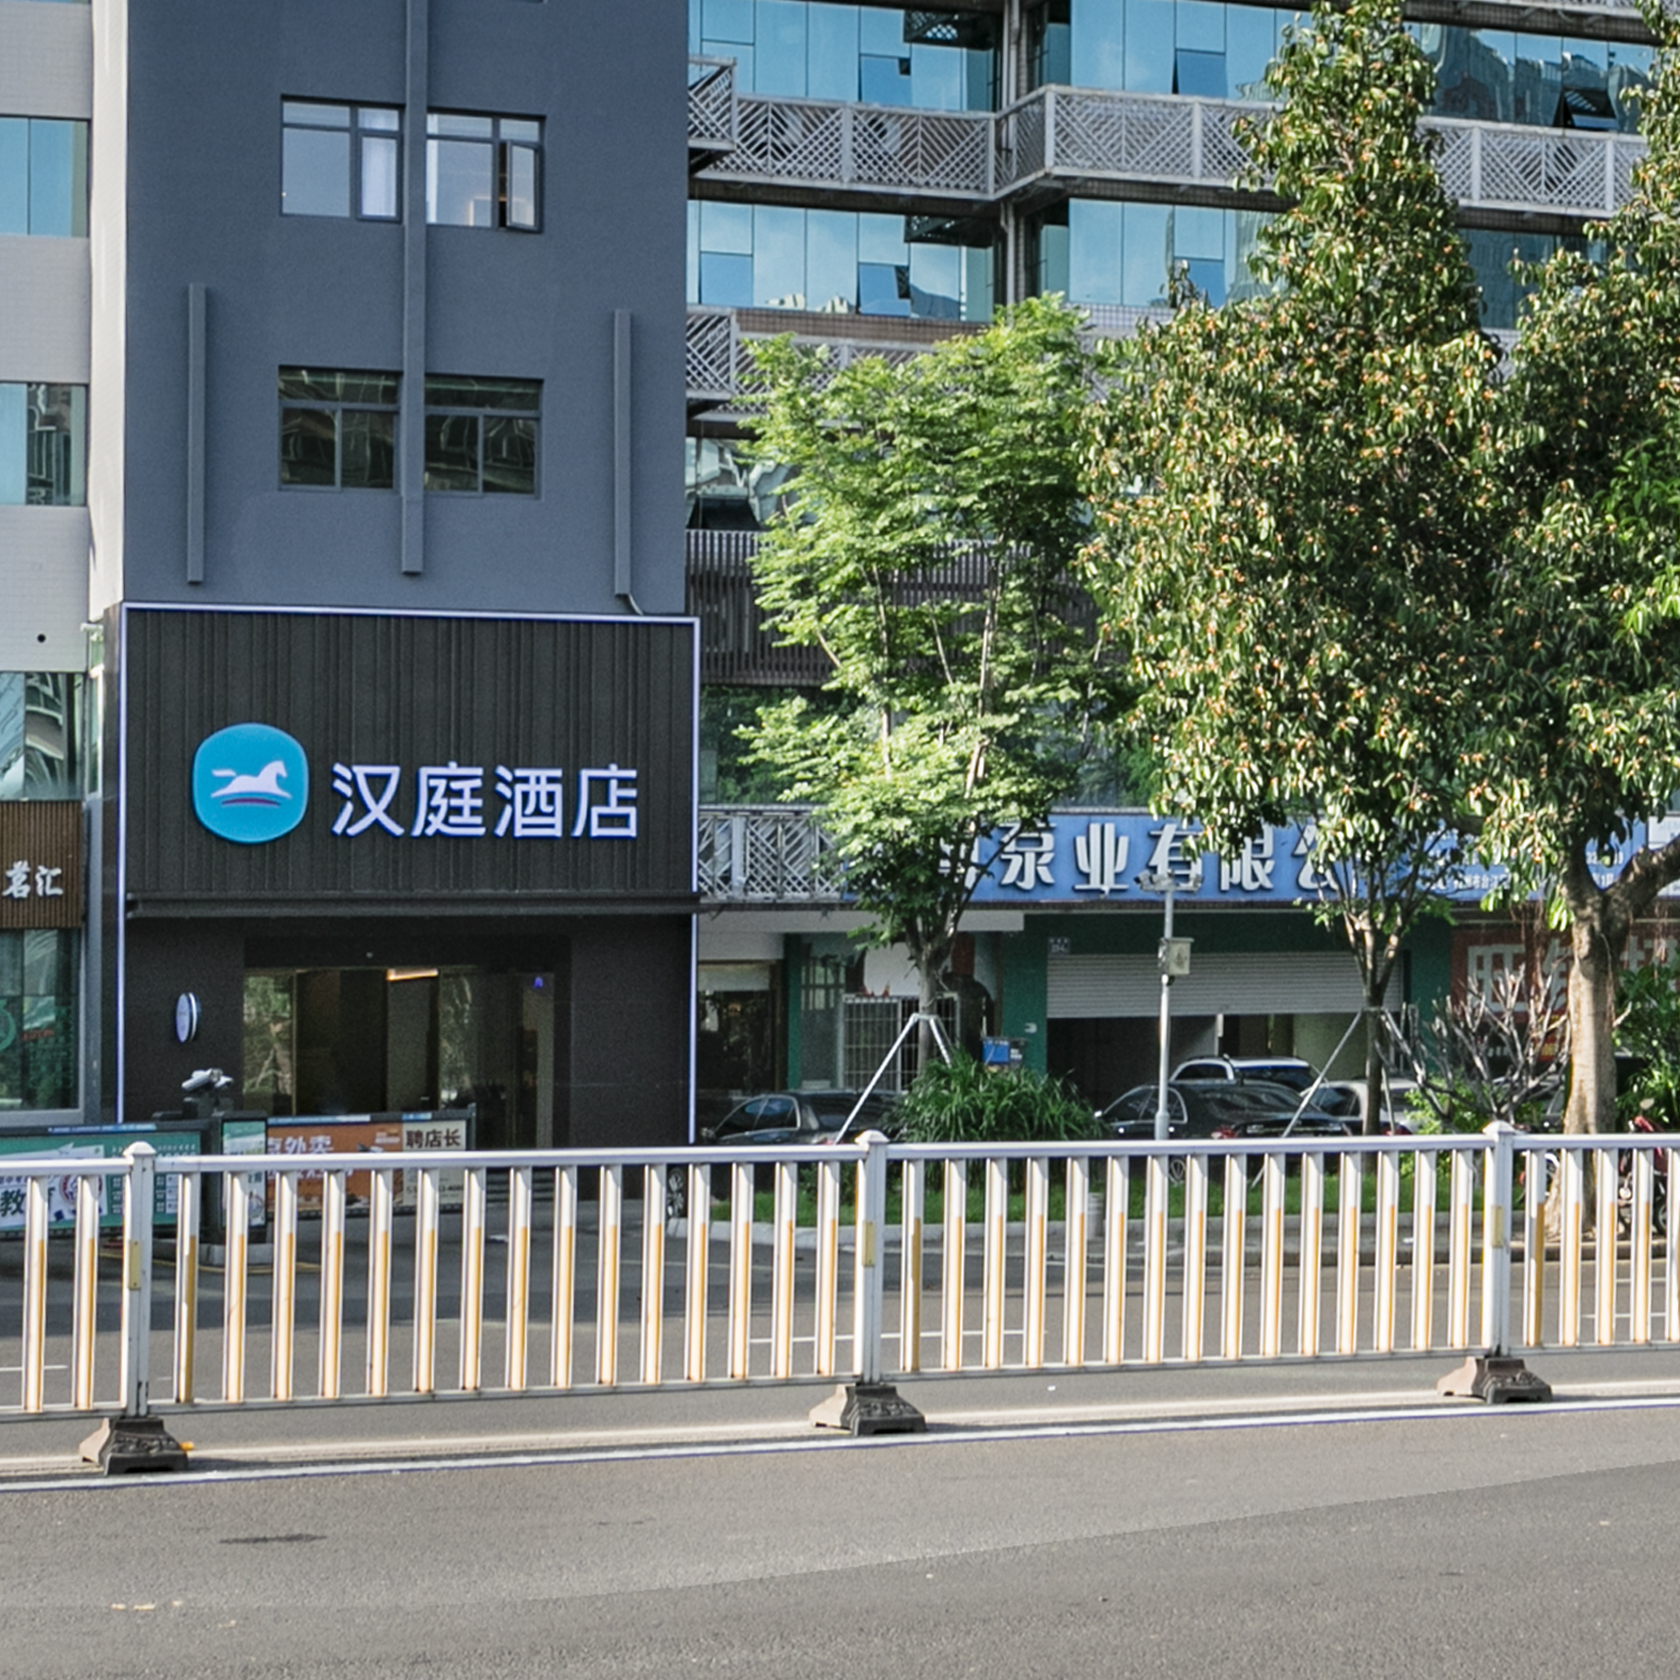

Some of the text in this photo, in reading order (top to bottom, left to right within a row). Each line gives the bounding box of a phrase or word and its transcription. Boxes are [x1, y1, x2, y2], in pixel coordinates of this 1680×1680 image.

[331, 761, 639, 839] 汉庭酒店
[405, 1128, 462, 1150] 聘店长
